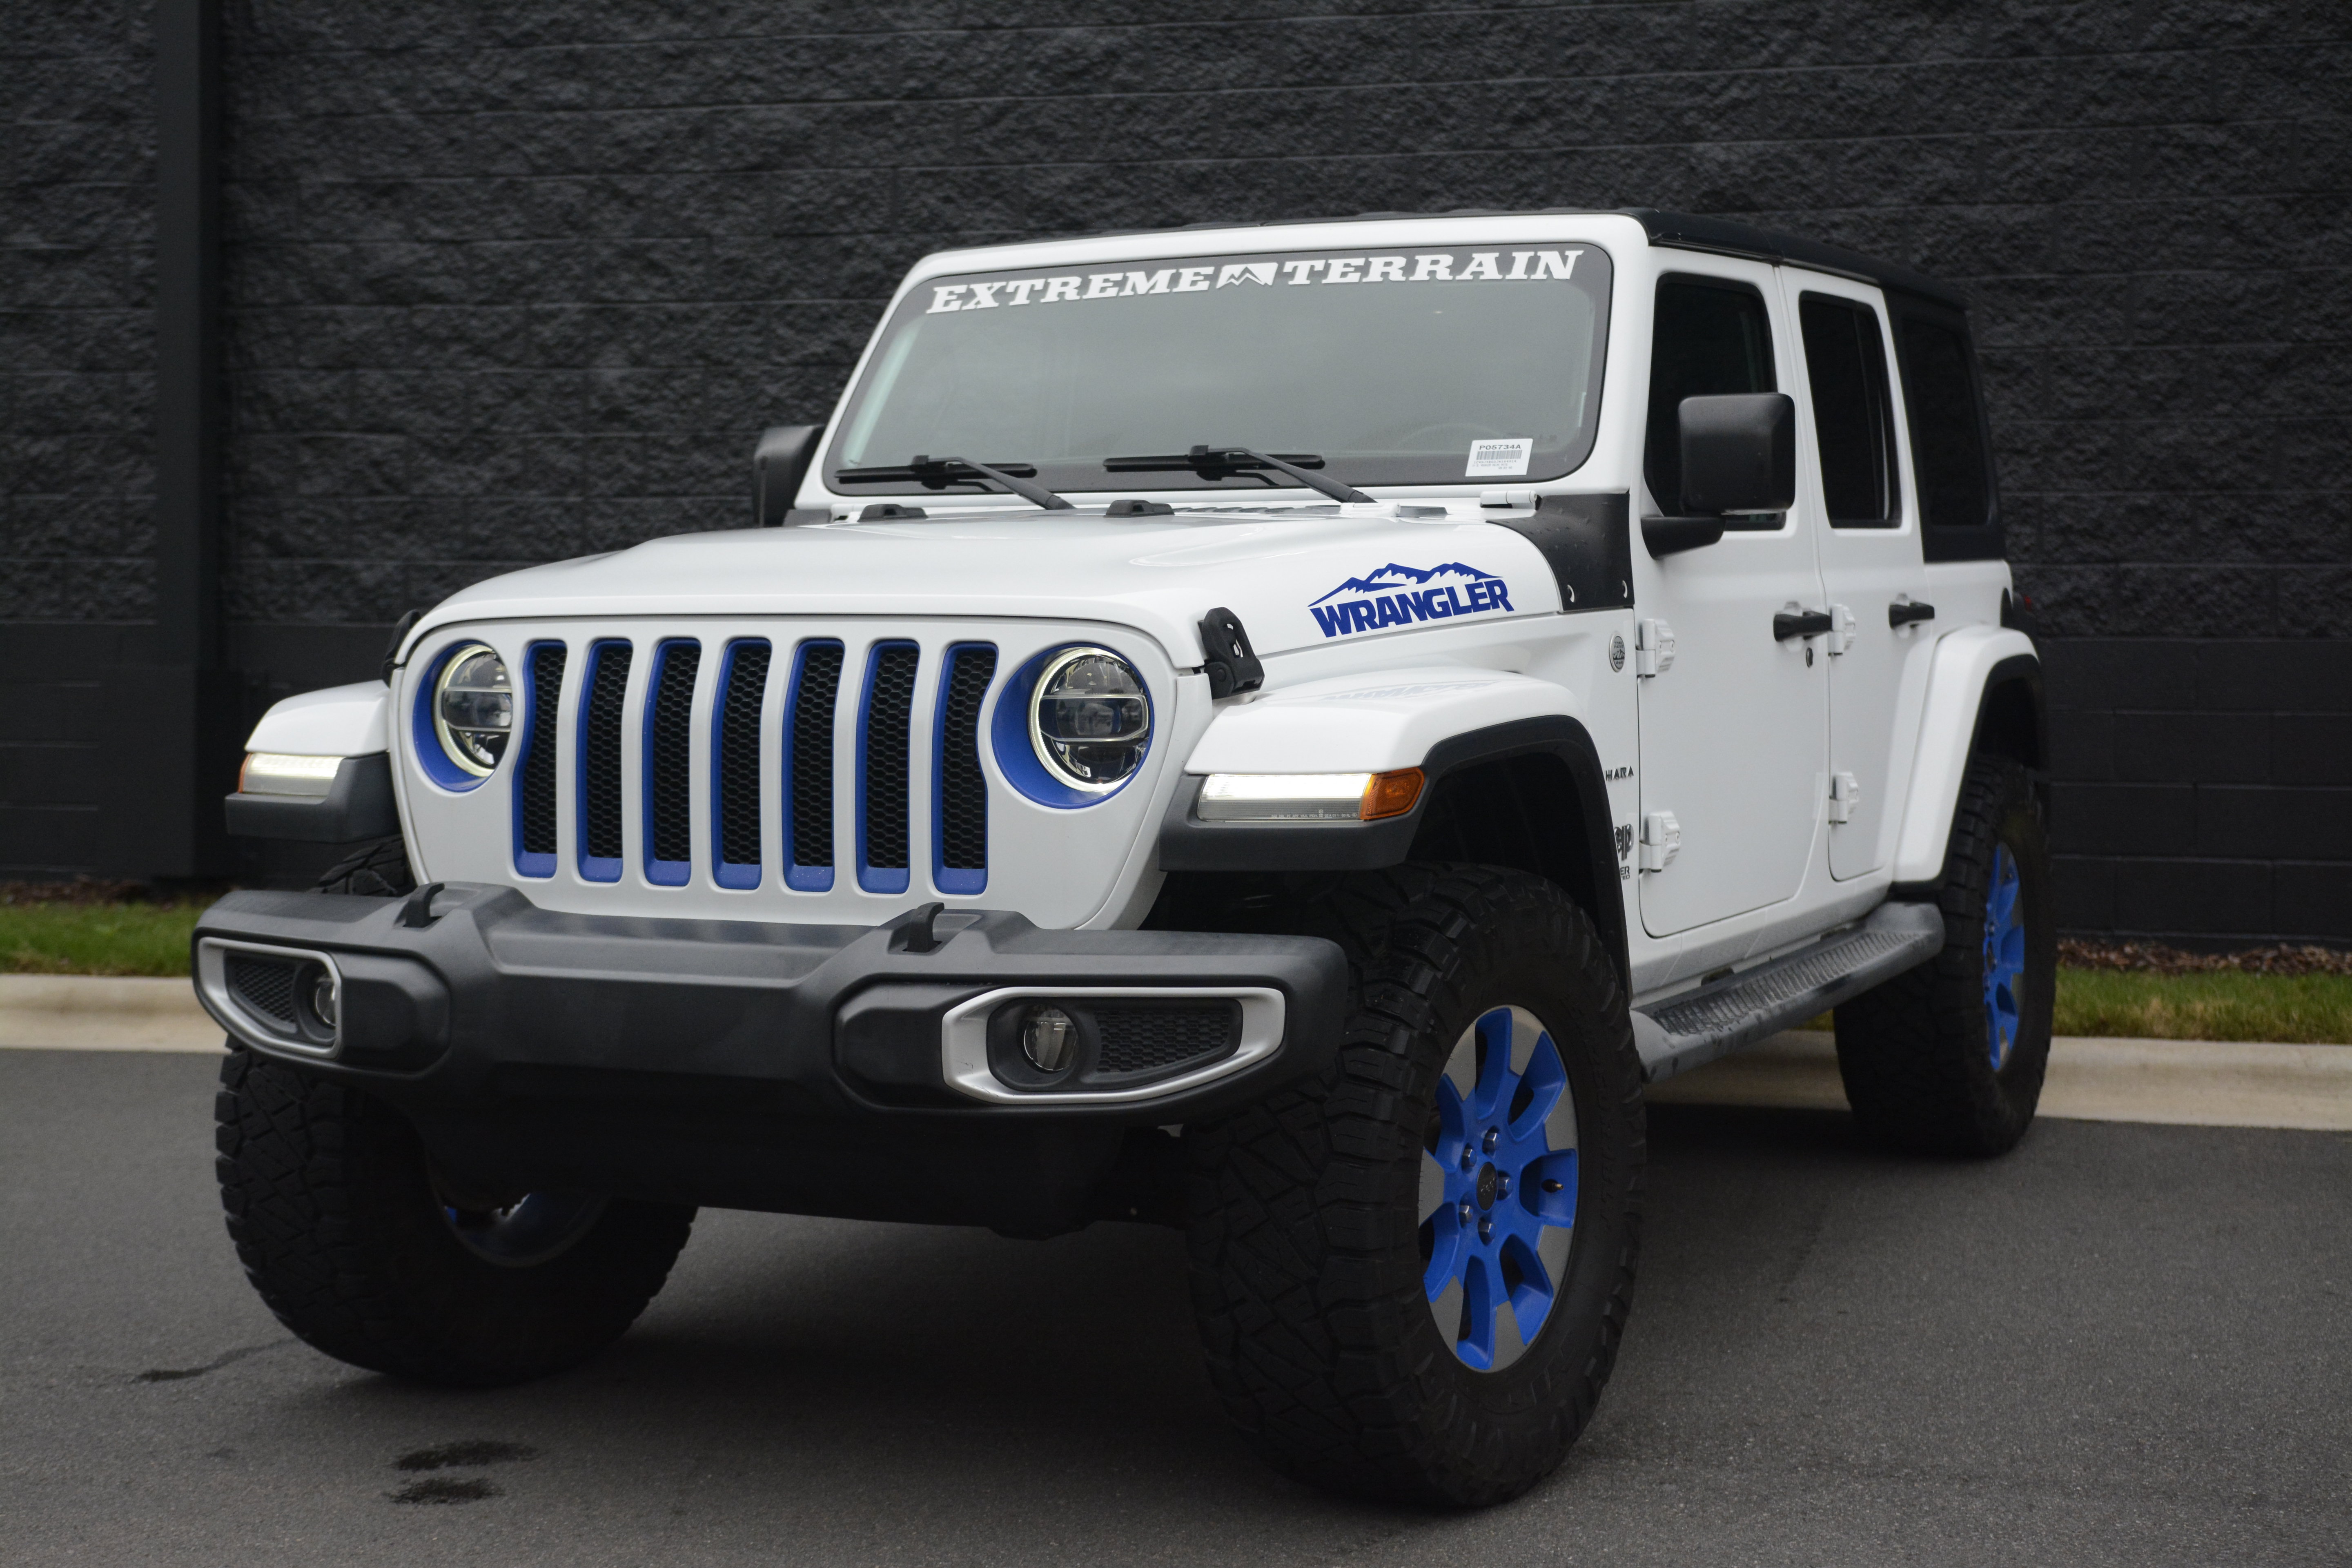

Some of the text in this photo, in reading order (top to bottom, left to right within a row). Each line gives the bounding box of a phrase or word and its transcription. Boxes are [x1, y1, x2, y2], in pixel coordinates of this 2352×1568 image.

[927, 250, 1584, 314] EXTREME TERRAIN
[1310, 579, 1515, 637] WRANGLER
[1606, 766, 1634, 781] HARA
